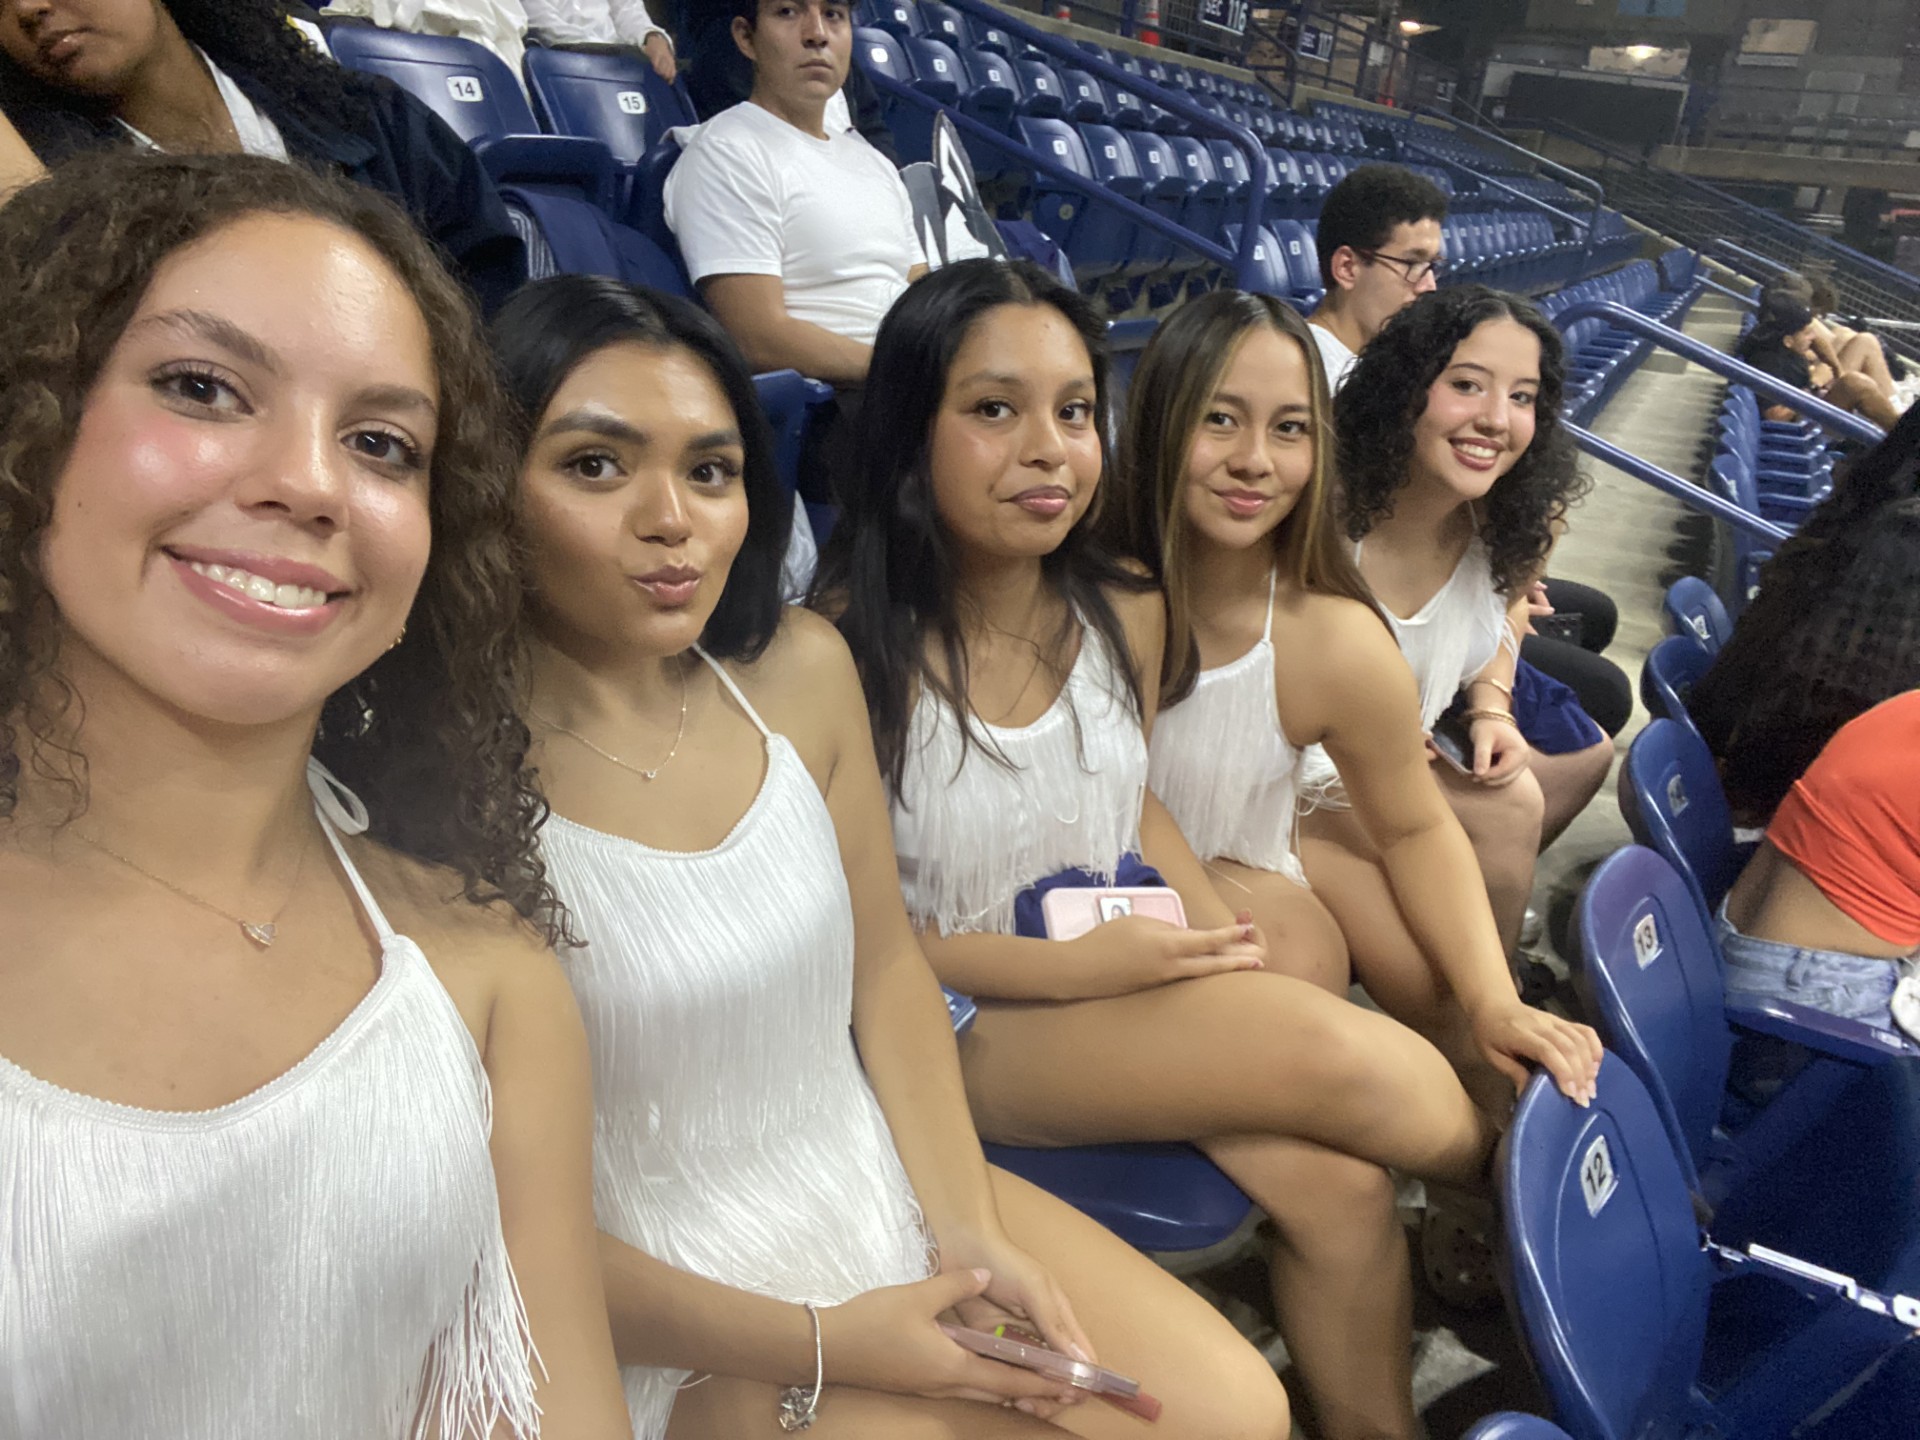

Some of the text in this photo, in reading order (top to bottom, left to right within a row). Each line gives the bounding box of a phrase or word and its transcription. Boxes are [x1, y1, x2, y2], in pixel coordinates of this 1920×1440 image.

[1205, 0, 1248, 31] SEC 116
[454, 81, 476, 97] 14
[623, 96, 641, 111] 15
[1637, 925, 1653, 956] 13
[1585, 1151, 1607, 1196] 12
